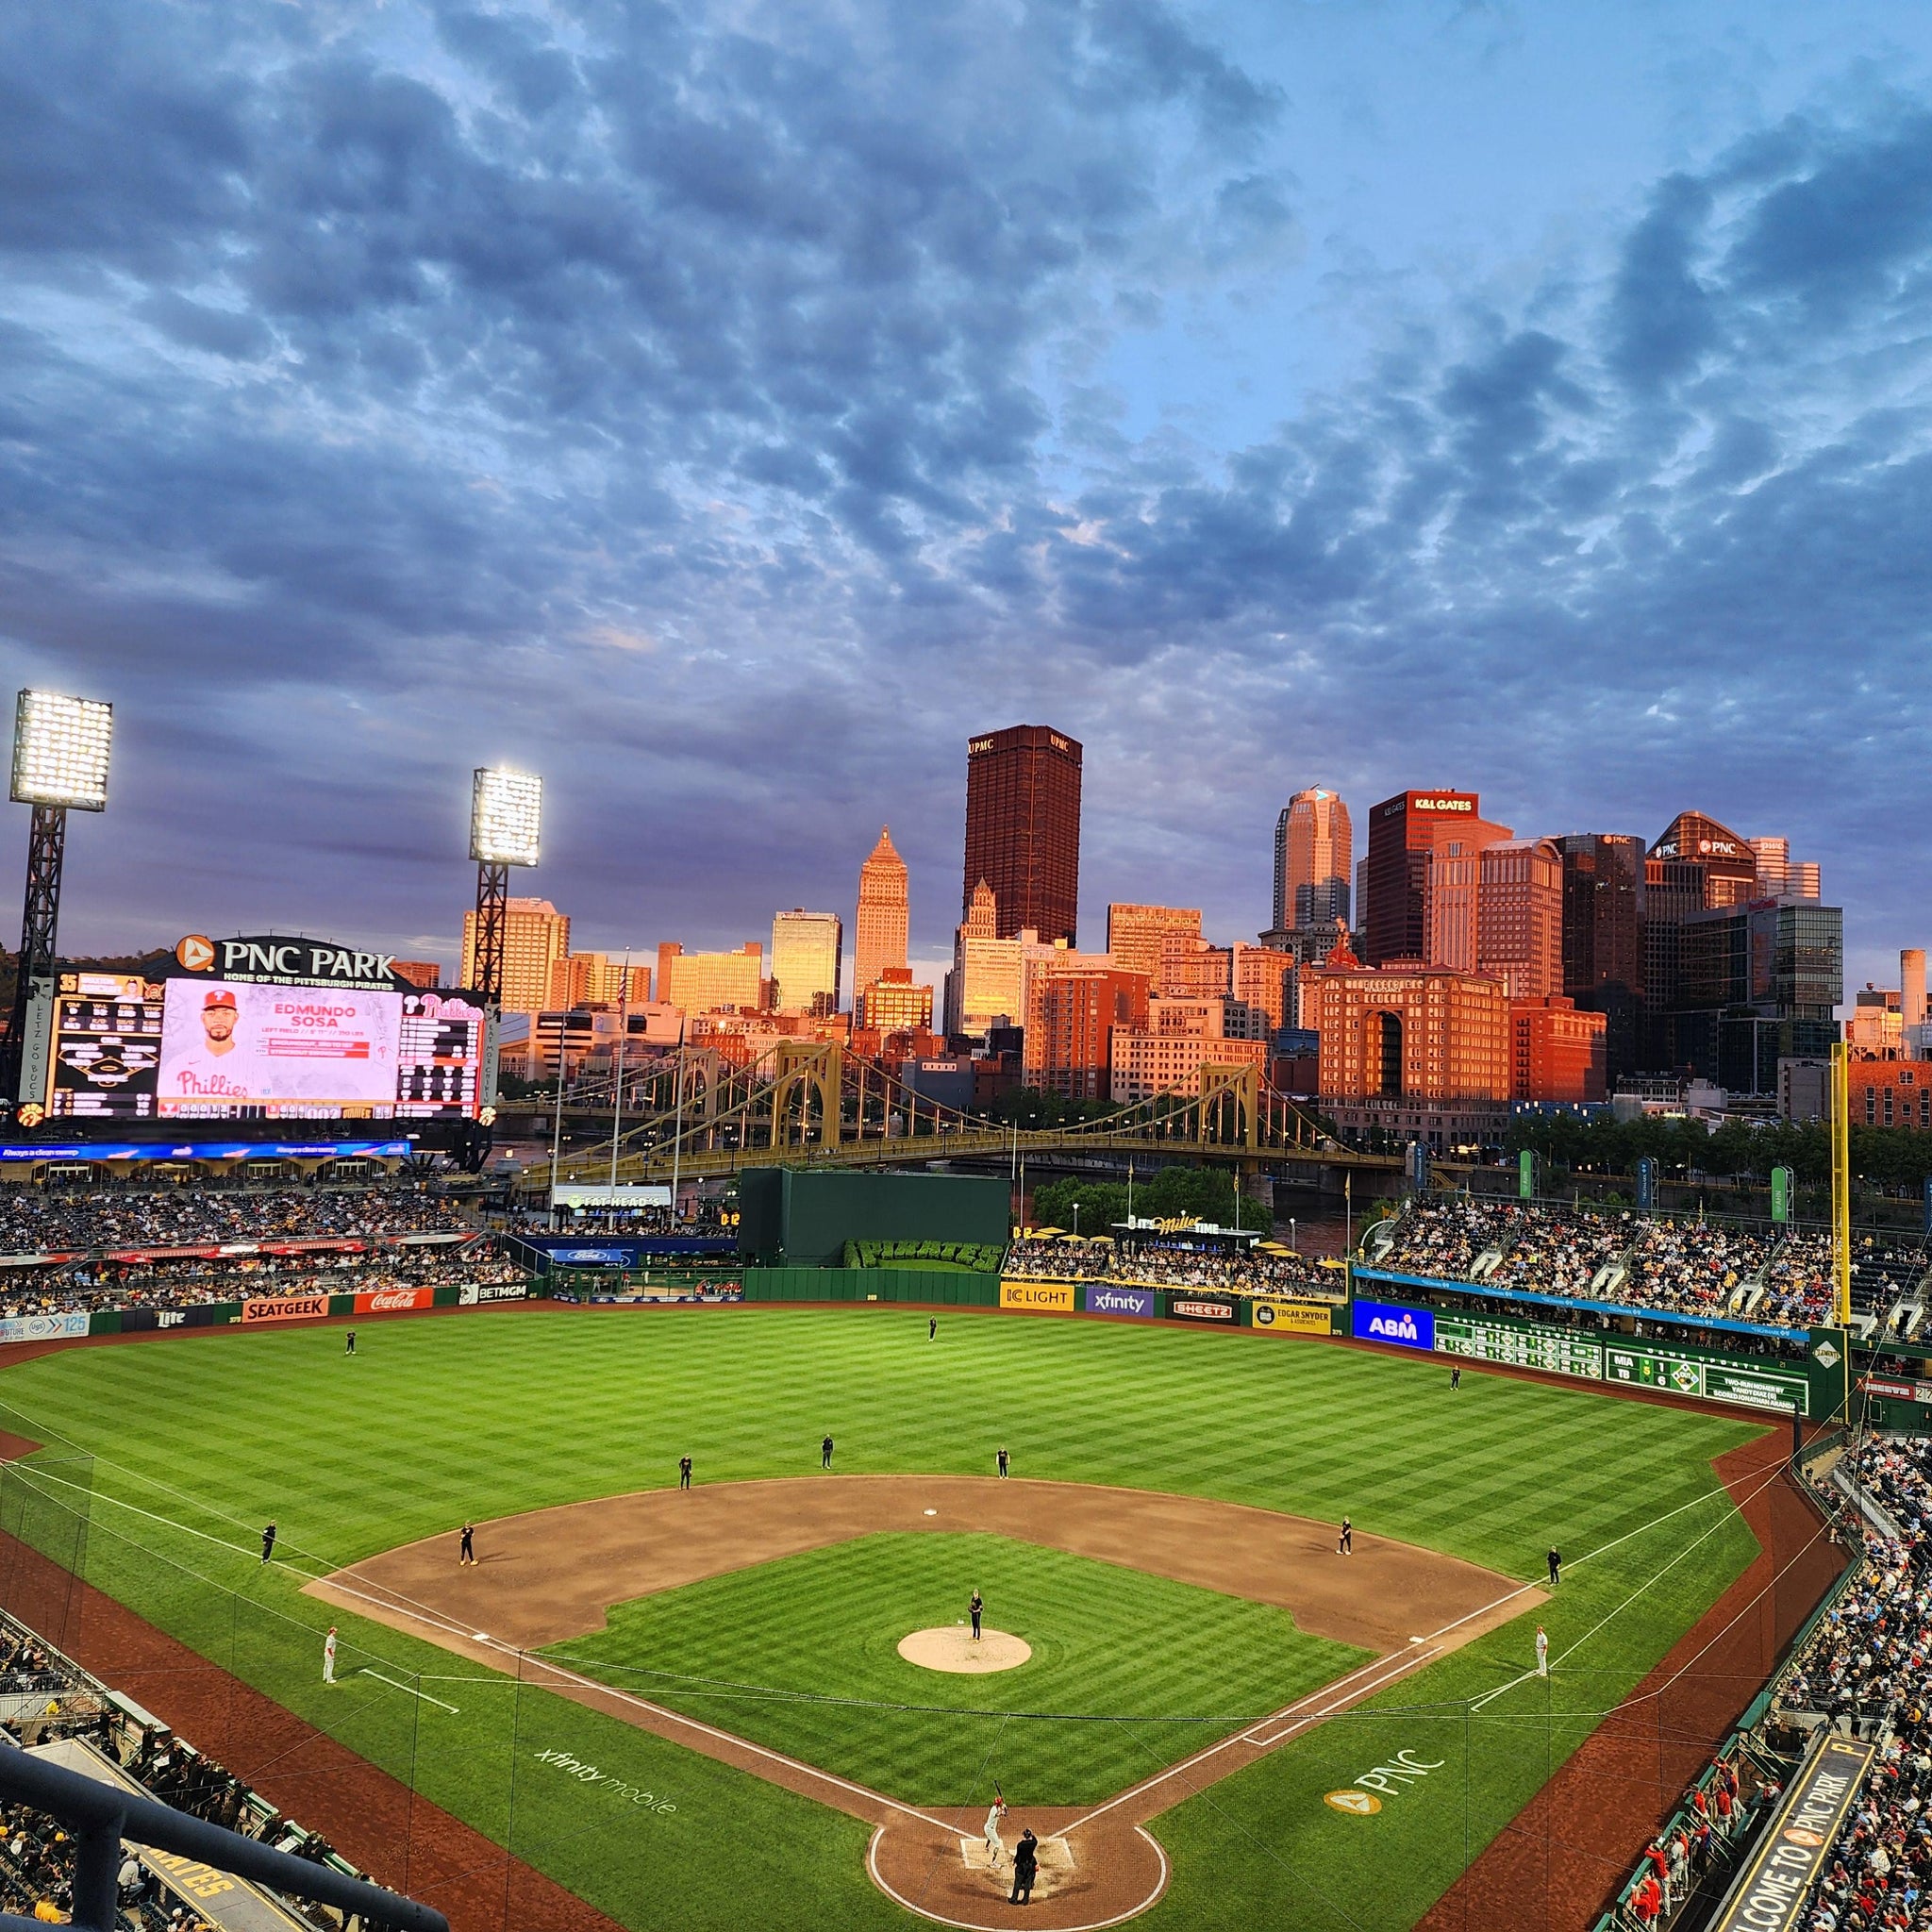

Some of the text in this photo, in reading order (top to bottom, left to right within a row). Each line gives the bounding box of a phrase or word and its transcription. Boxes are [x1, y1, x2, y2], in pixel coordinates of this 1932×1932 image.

[968, 739, 994, 754] UPMC
[1050, 734, 1070, 752] UPMC
[1391, 801, 1406, 812] GATES
[1415, 799, 1472, 811] K&L GATES
[1612, 836, 1631, 844] PNC
[1711, 841, 1737, 855] PNC
[1662, 842, 1677, 855] PNC
[222, 941, 396, 980] PNC PARK
[59, 974, 77, 991] 35
[224, 973, 394, 991] HOME OF THE PITTSBURGH PIRATES
[275, 1004, 356, 1017] EDMUNDO
[420, 993, 485, 1020] Phillies
[34, 1004, 43, 1038] LETZ
[291, 1016, 339, 1027] SOSA
[31, 1043, 40, 1059] GO
[28, 1065, 39, 1099] BUCS
[177, 1072, 248, 1098] Phillies
[483, 1067, 491, 1104] CHIKIN
[584, 1197, 660, 1207] FAT HEAD'S
[721, 1213, 740, 1225] 0:12
[1138, 1216, 1219, 1235] IT'S Miller TIME
[575, 1250, 600, 1259] Ford
[858, 1240, 1004, 1273] PIRATES
[479, 1285, 526, 1298] BETMGM
[1007, 1290, 1067, 1304] IC LIGHT
[247, 1298, 323, 1319] SEATGEEK
[1094, 1292, 1144, 1312] xfinity
[1177, 1304, 1227, 1315] SHEETZ
[158, 1311, 186, 1327] Lite
[1277, 1309, 1300, 1318] EDGAR
[1301, 1311, 1328, 1321] SNYDER
[63, 1316, 86, 1332] 125
[1369, 1317, 1417, 1340] ABM
[1530, 1323, 1557, 1331] WELCOME
[1614, 1356, 1634, 1367] MIA
[1647, 1348, 1759, 1371] GAME UPDATE
[1813, 1349, 1840, 1361] CLEMENTE
[1658, 1362, 1664, 1373] 1
[1617, 1369, 1666, 1386] TB 6
[1724, 1378, 1754, 1389] TWO-RUN
[1754, 1382, 1775, 1391] HOMER
[1713, 1390, 1738, 1399] SCORED
[1738, 1394, 1770, 1405] JONATHAN
[1732, 1386, 1753, 1395] YANDY
[1754, 1390, 1767, 1398] DIAZ
[1830, 1415, 1843, 1424] 320
[1353, 1749, 1445, 1795] PNC
[534, 1748, 676, 1815] xfinity mobile
[1807, 1771, 1849, 1806] PARK
[1793, 1802, 1834, 1833] PNC
[1771, 1845, 1812, 1871] TO
